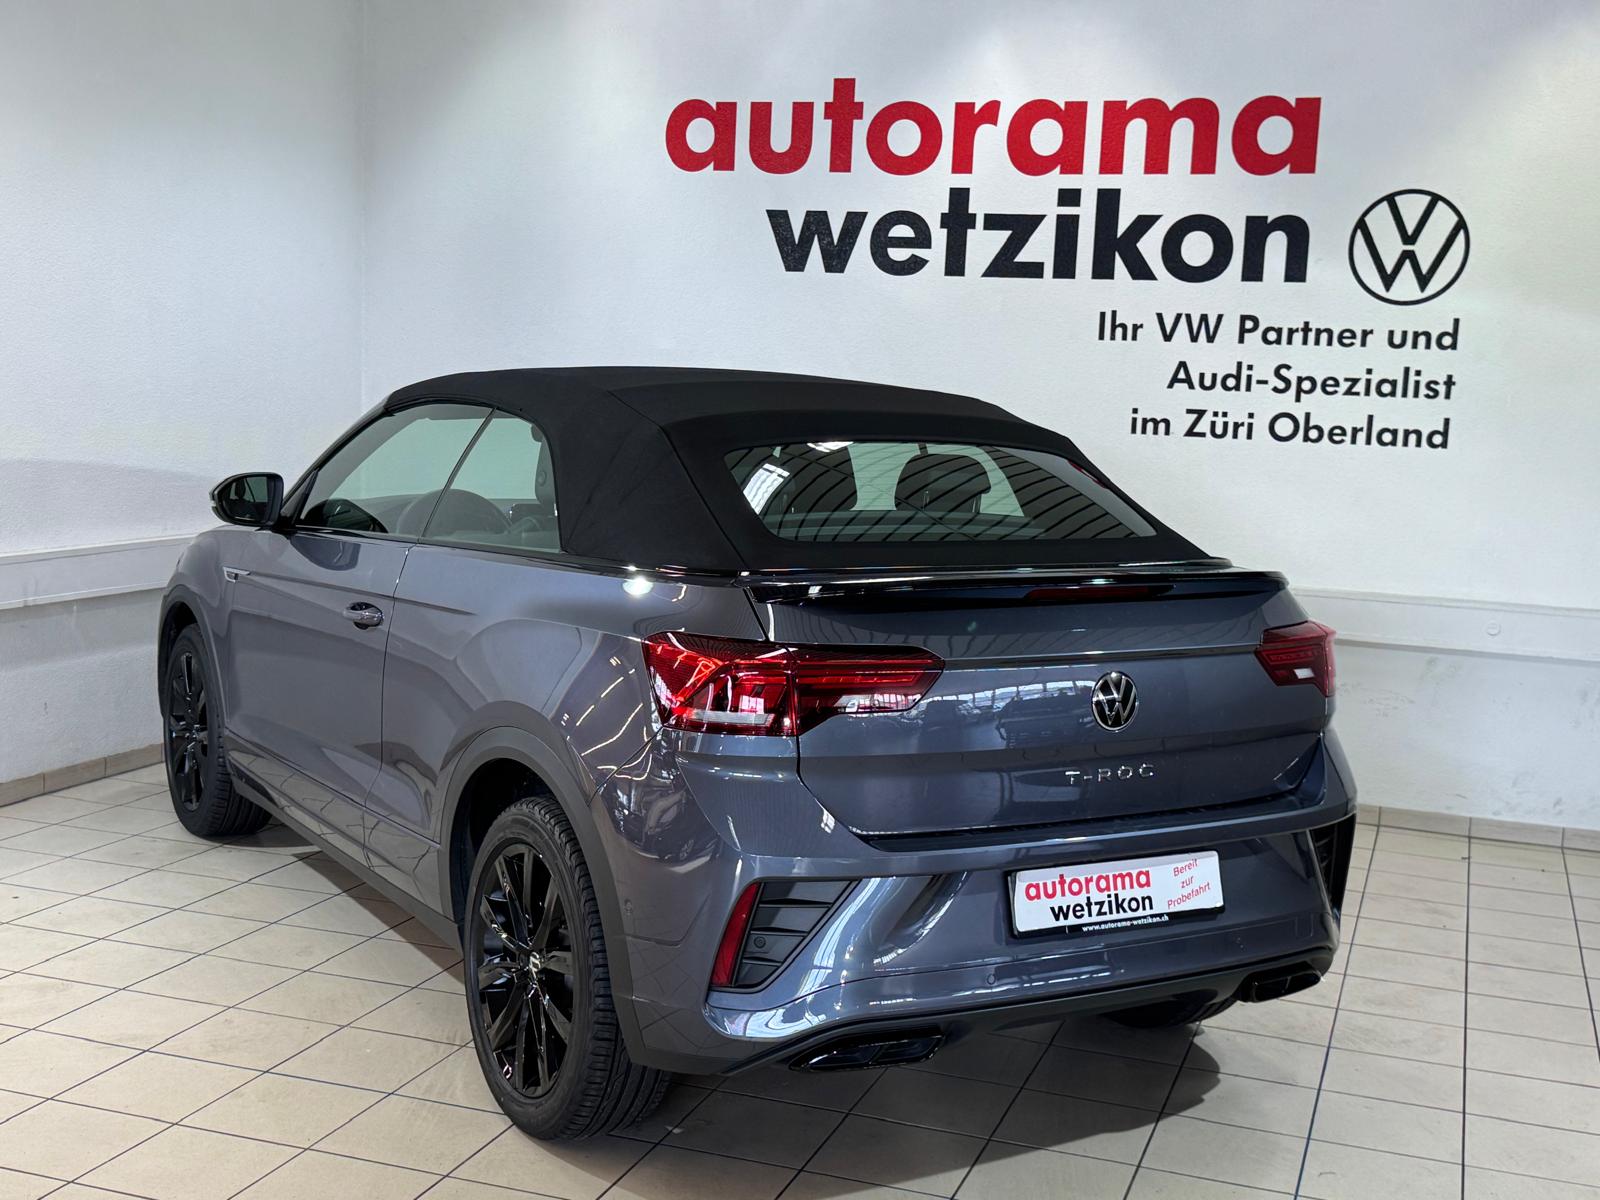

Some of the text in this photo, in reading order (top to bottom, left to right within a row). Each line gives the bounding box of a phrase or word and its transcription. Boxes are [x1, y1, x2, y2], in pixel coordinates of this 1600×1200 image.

[665, 77, 1322, 176] autorama
[766, 187, 1310, 283] wetzikon
[1349, 188, 1470, 305] VW
[1098, 310, 1460, 351] Ihr VW Partner und
[1166, 360, 1456, 402] Audi-Spezialist
[1130, 408, 1451, 449] im Züri Oberland
[1092, 670, 1138, 732] VW
[1065, 763, 1154, 784] T-ROC
[1024, 869, 1151, 901] autorama
[1172, 858, 1198, 877] Bereit
[1181, 875, 1194, 888] zur
[1050, 893, 1154, 922] wetzikon
[1167, 881, 1211, 909] Probefahrt
